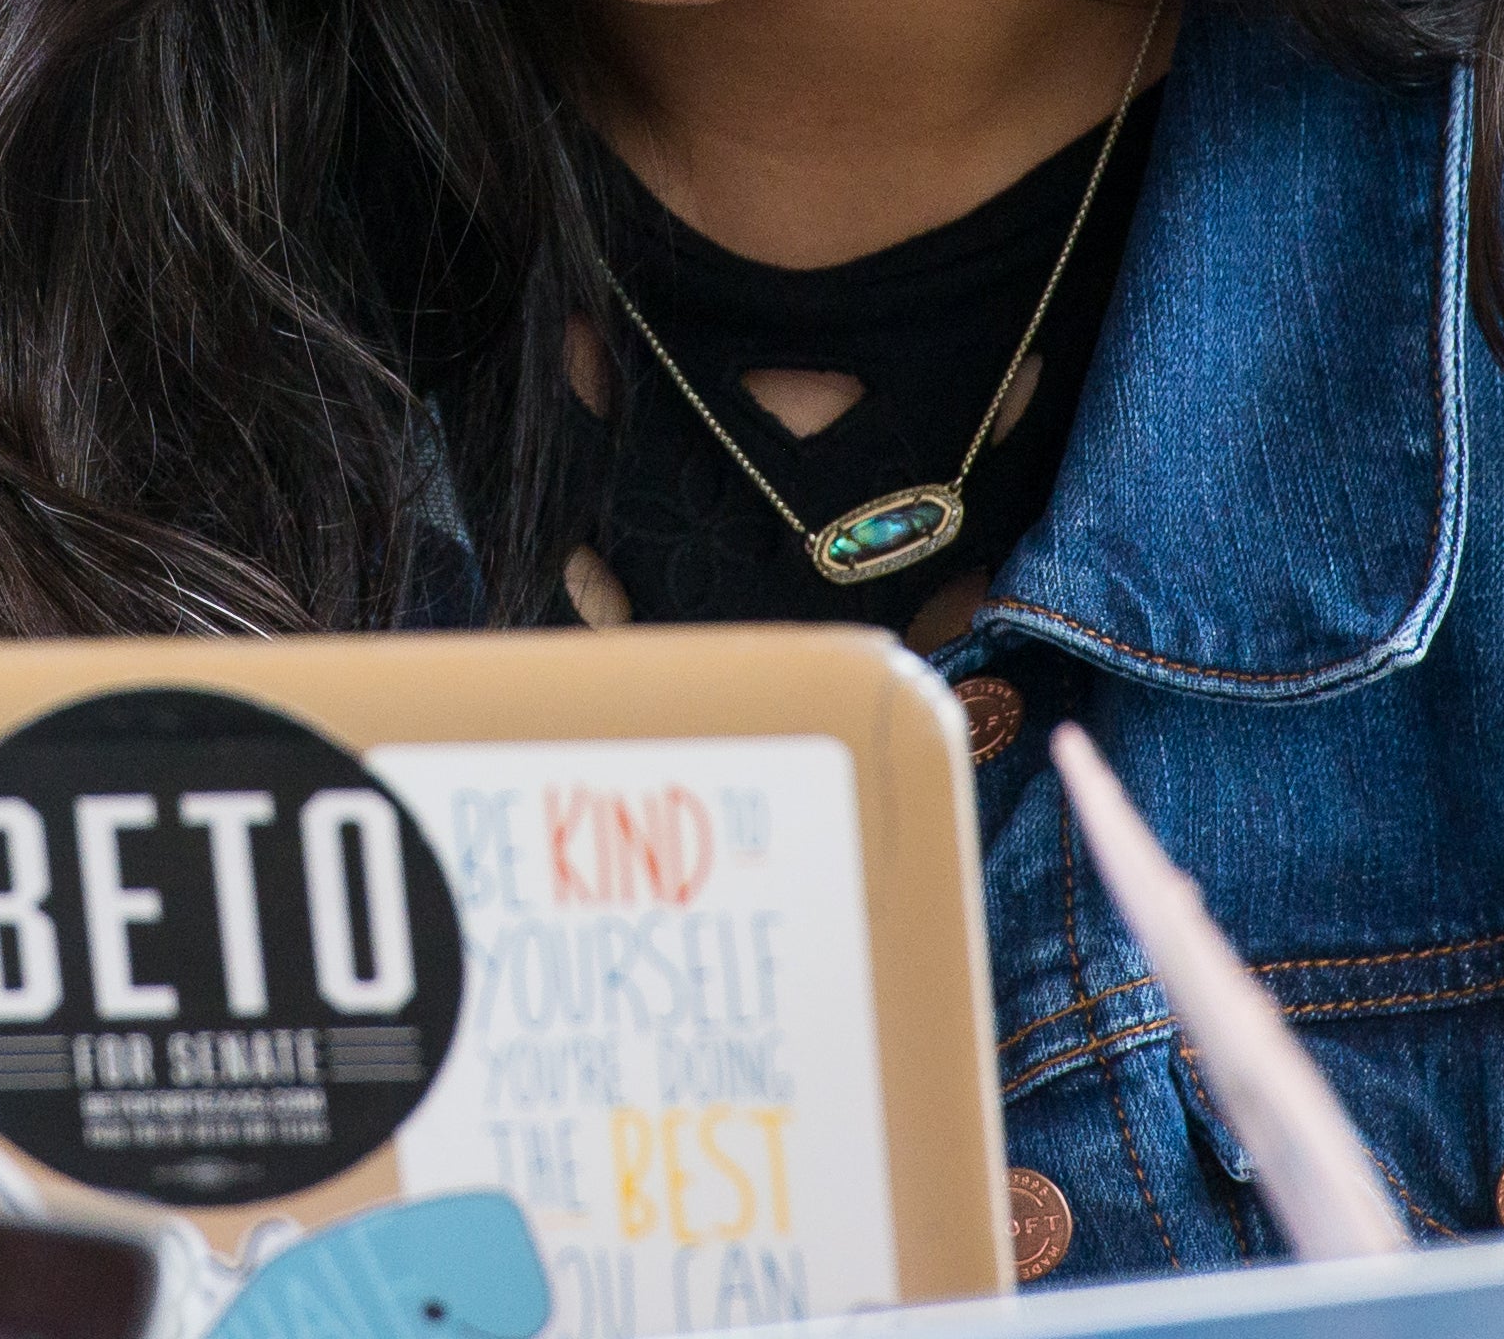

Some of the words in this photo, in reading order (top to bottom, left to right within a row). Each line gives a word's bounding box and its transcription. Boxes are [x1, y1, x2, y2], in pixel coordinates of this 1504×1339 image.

[450, 788, 522, 908] BE
[542, 783, 714, 905] KIND
[470, 909, 783, 1033] YOURSELF
[72, 1032, 155, 1088] FOR
[489, 1119, 586, 1214] THE
[609, 1105, 795, 1245] BEST
